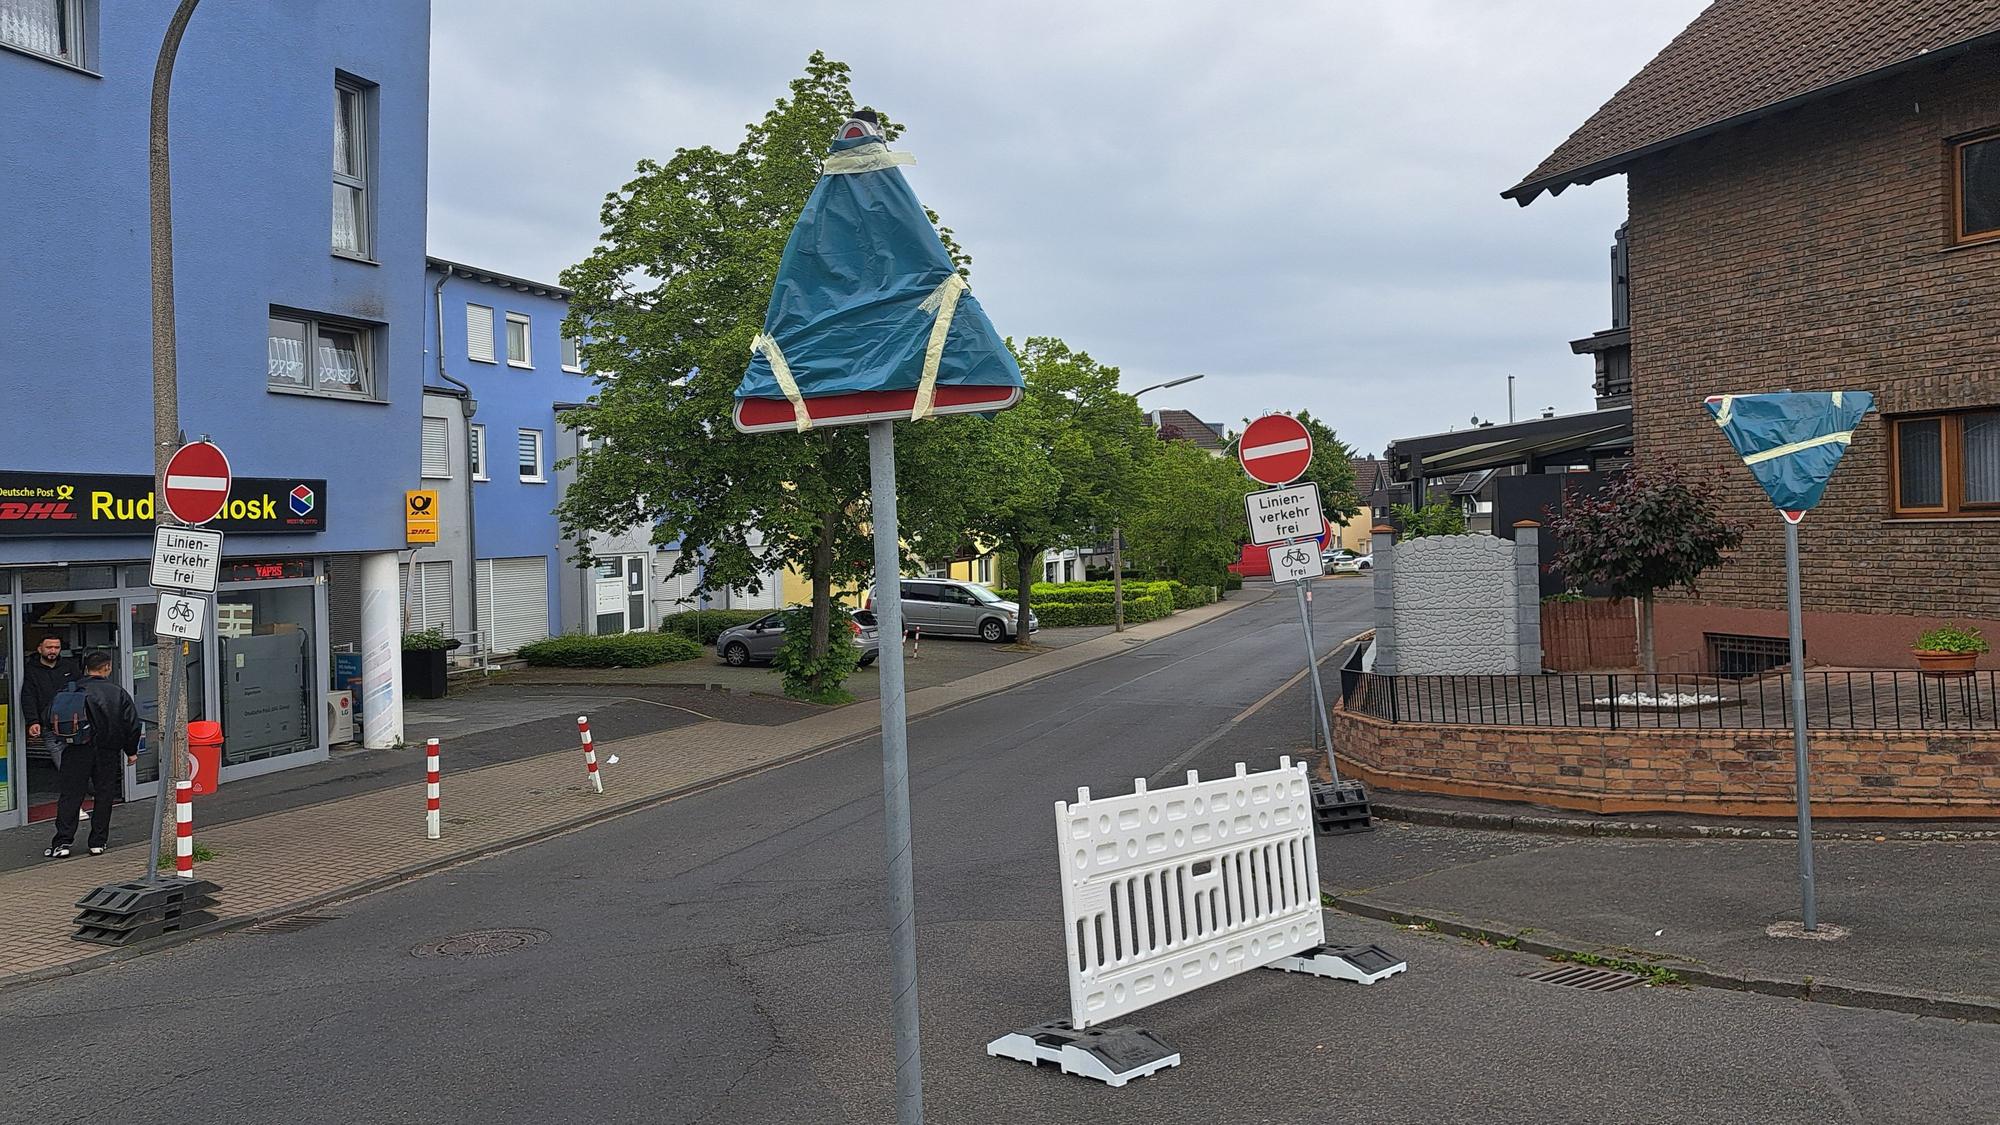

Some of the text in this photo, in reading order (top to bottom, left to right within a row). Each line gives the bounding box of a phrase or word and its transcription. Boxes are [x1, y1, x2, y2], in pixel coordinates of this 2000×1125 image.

[36, 487, 55, 497] Post
[91, 491, 277, 520] Rud iosk
[1258, 494, 1305, 510] Linien-
[0, 502, 74, 519] DHL
[1259, 506, 1310, 524] verkehr
[1276, 521, 1299, 536] frei
[166, 534, 209, 550] Linien-
[162, 553, 210, 568] verkehr
[173, 569, 195, 584] frei
[1290, 566, 1307, 577] frei
[171, 622, 187, 634] frei
